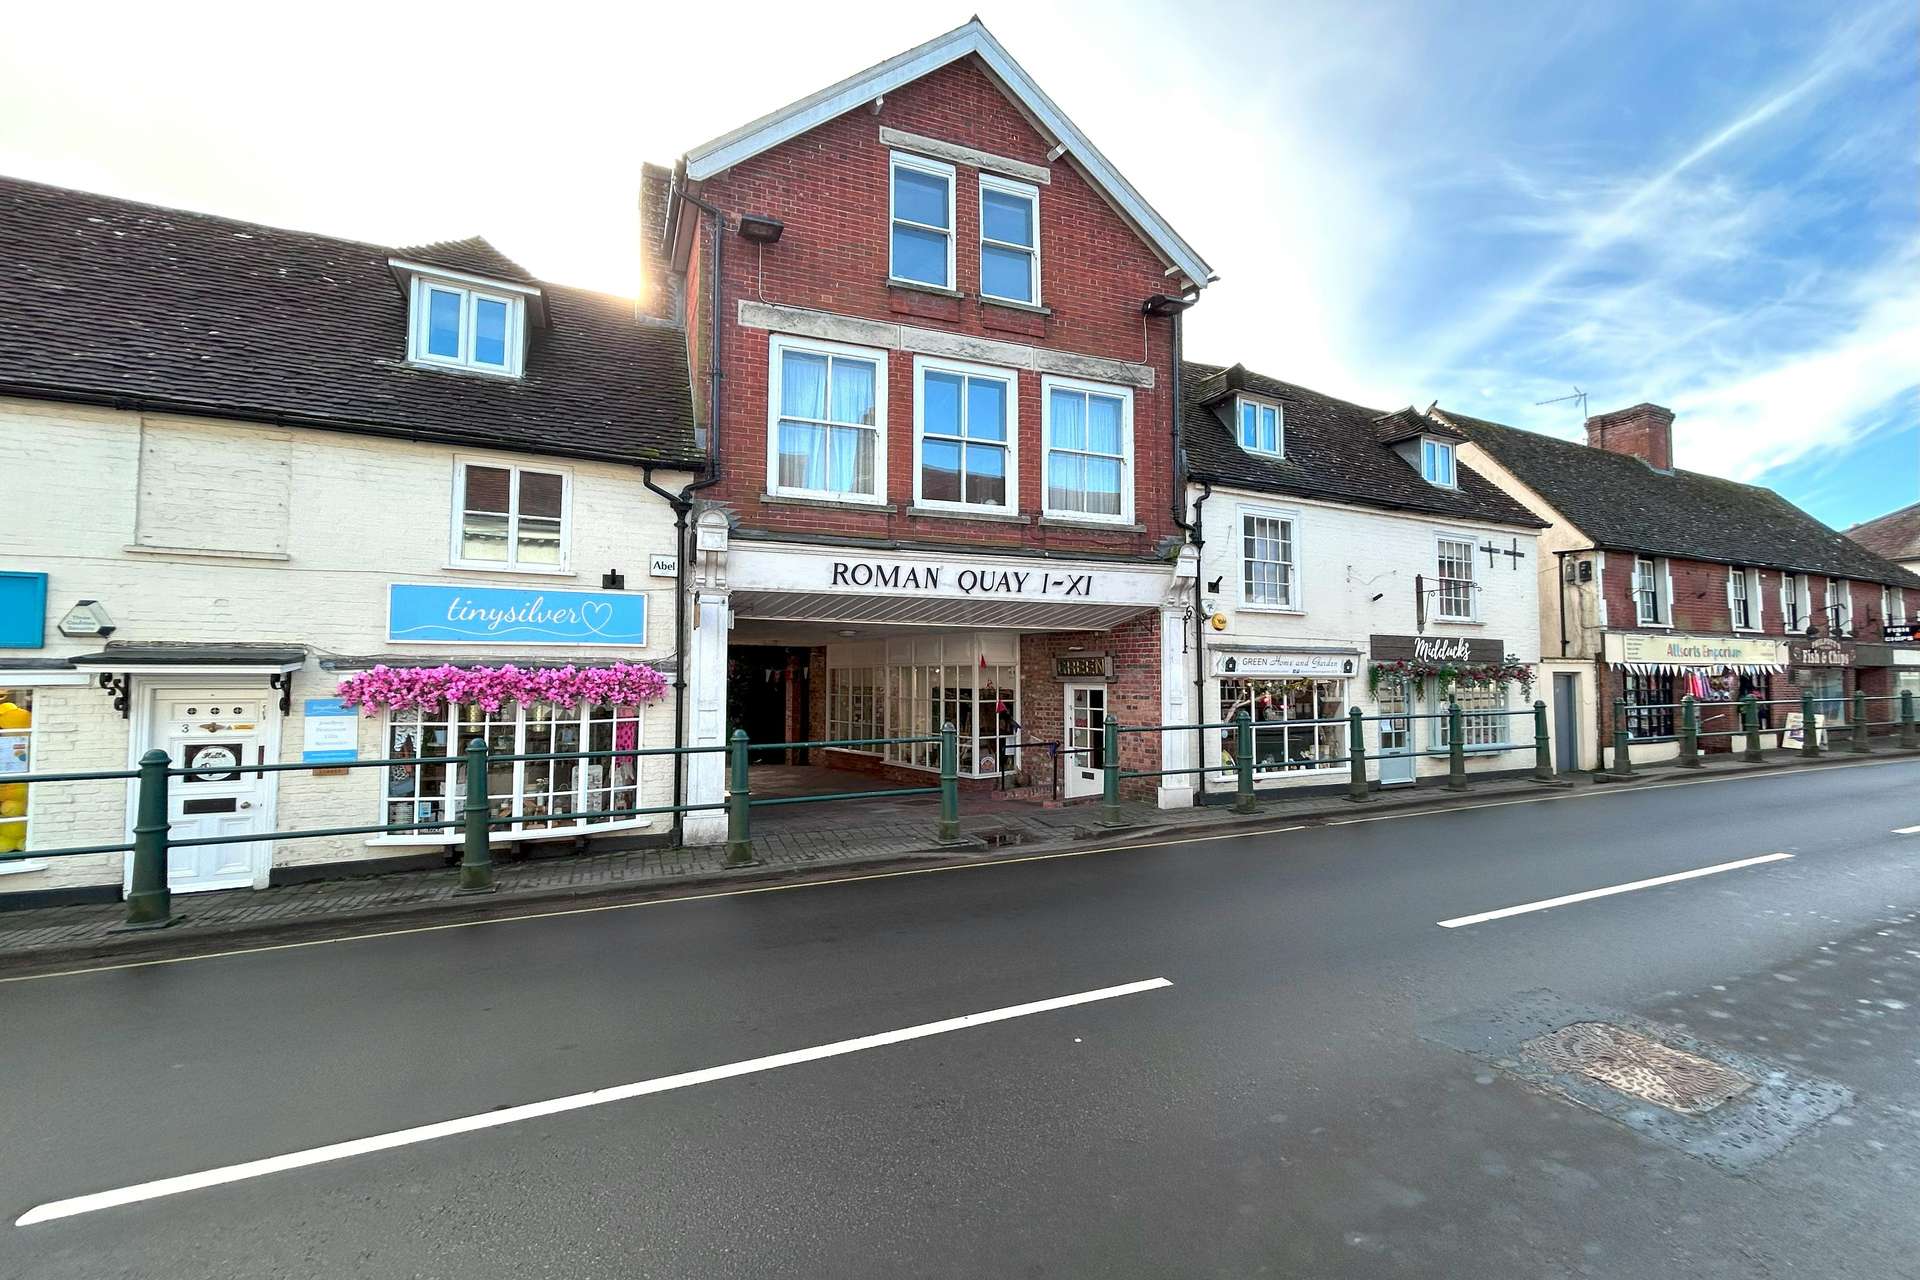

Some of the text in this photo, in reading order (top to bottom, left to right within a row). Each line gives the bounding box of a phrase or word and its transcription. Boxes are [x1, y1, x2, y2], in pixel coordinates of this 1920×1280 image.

[653, 560, 676, 571] Abel
[831, 561, 940, 589] ROMAN
[957, 569, 1029, 595] QUAY
[447, 596, 581, 631] tinysilver
[1666, 642, 1700, 658] Allsorts
[1702, 644, 1742, 661] Emporium
[1802, 649, 1820, 664] Fish
[1828, 649, 1849, 666] Chips
[1058, 658, 1105, 675] GREEN
[1242, 654, 1338, 669] GREEN Home and Garden
[181, 723, 190, 733] 3
